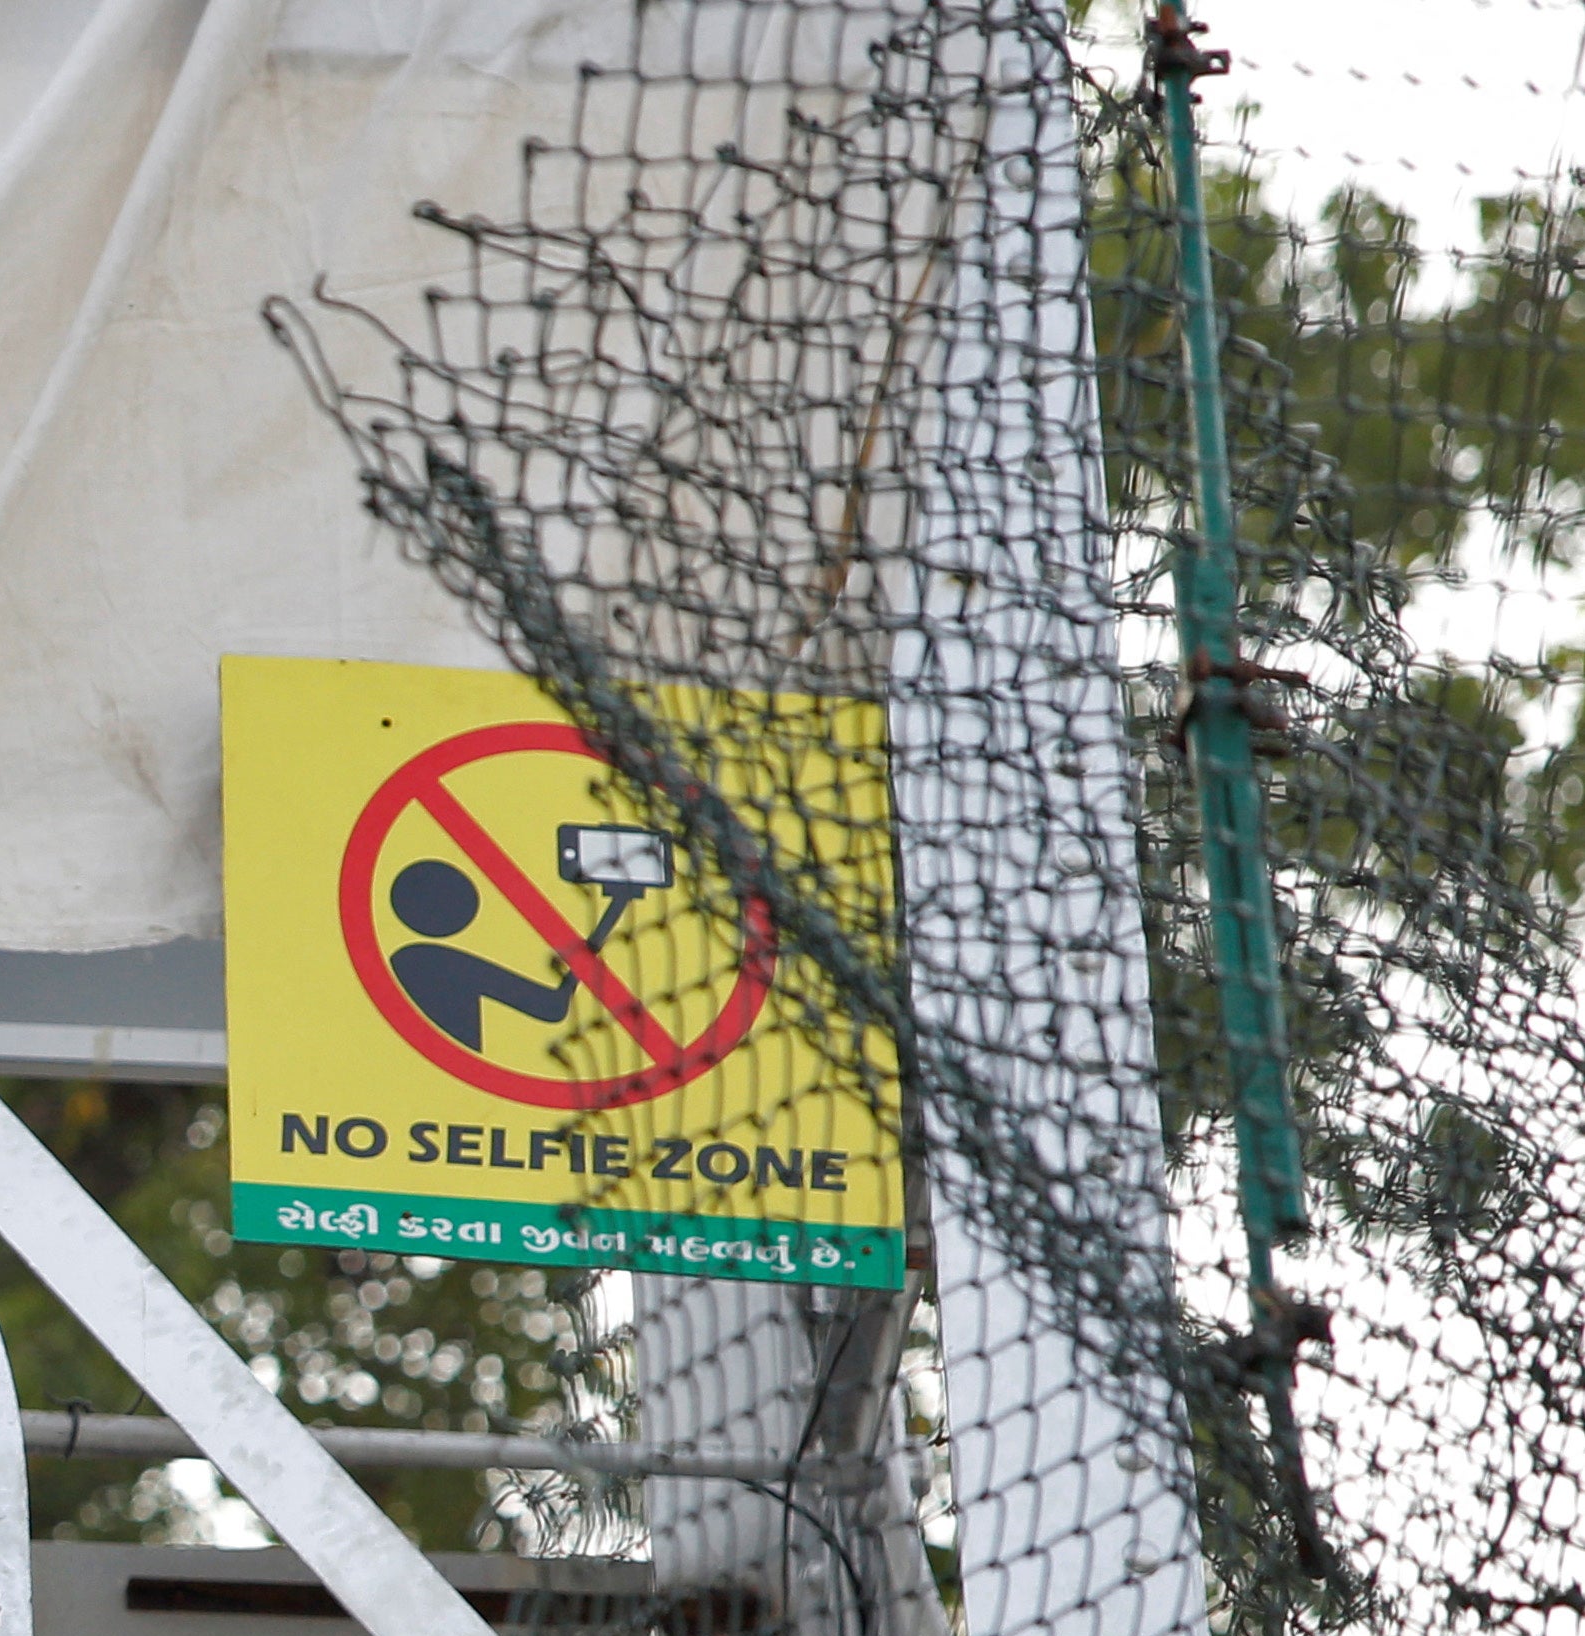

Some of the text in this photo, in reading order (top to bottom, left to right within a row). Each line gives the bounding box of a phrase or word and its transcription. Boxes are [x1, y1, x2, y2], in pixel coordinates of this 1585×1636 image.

[281, 1113, 848, 1192] NO SELFIE ZONE
[397, 1215, 502, 1244] કરતા
[519, 1224, 626, 1254] જીવન
